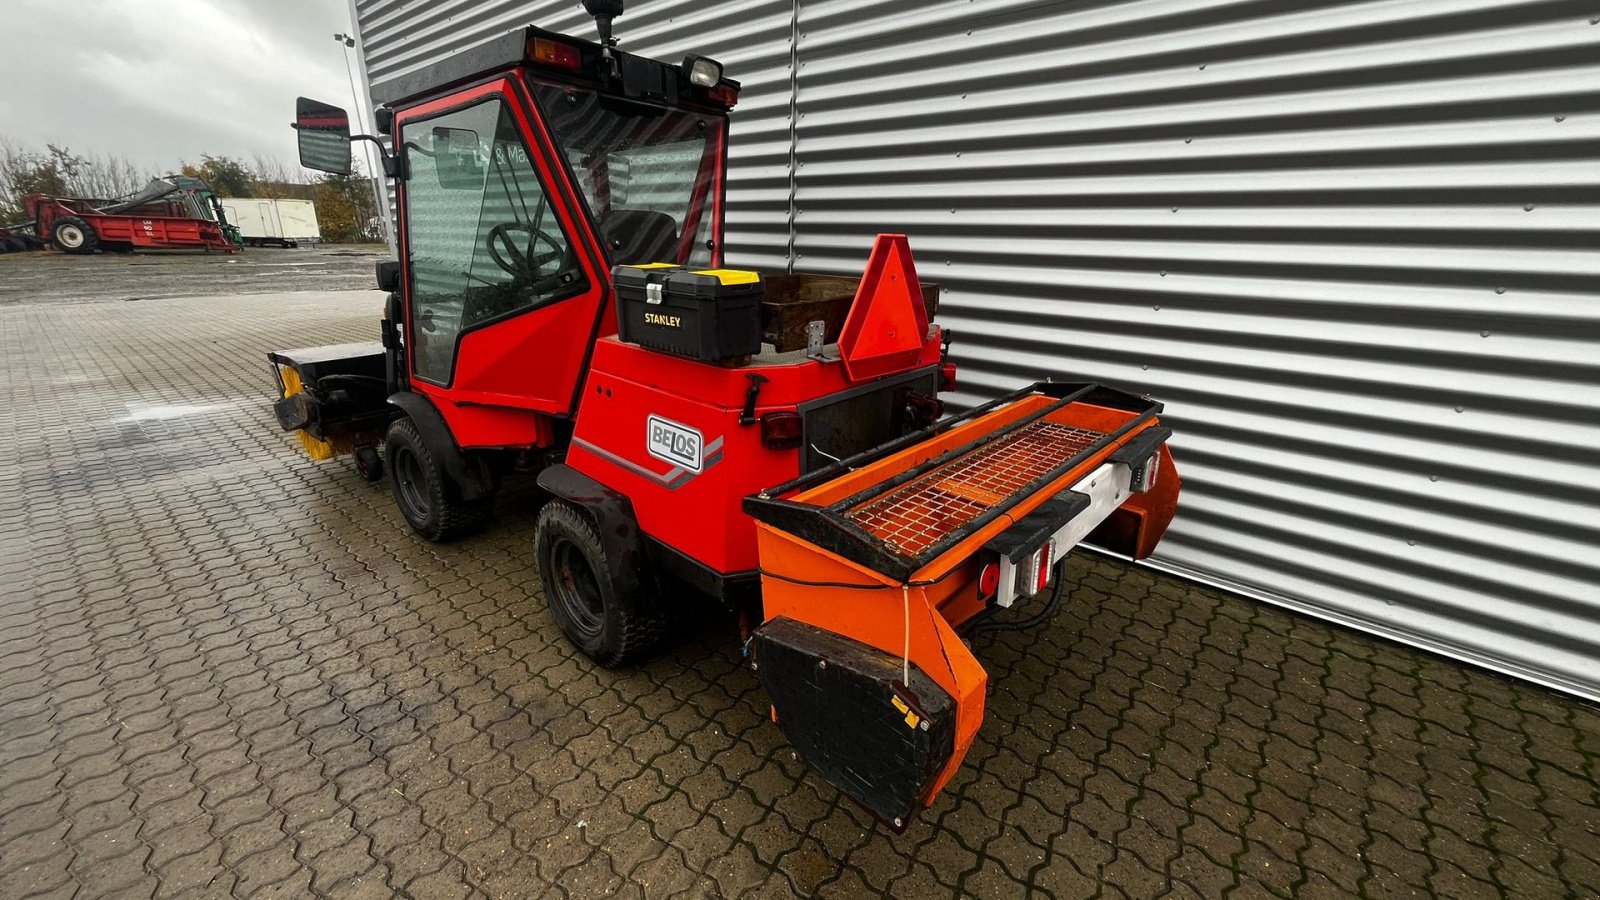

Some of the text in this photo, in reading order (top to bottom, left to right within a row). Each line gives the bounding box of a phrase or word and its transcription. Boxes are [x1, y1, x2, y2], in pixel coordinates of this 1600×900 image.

[507, 144, 529, 163] Ma
[644, 312, 681, 328] STANLEY
[652, 425, 696, 461] BELOS
